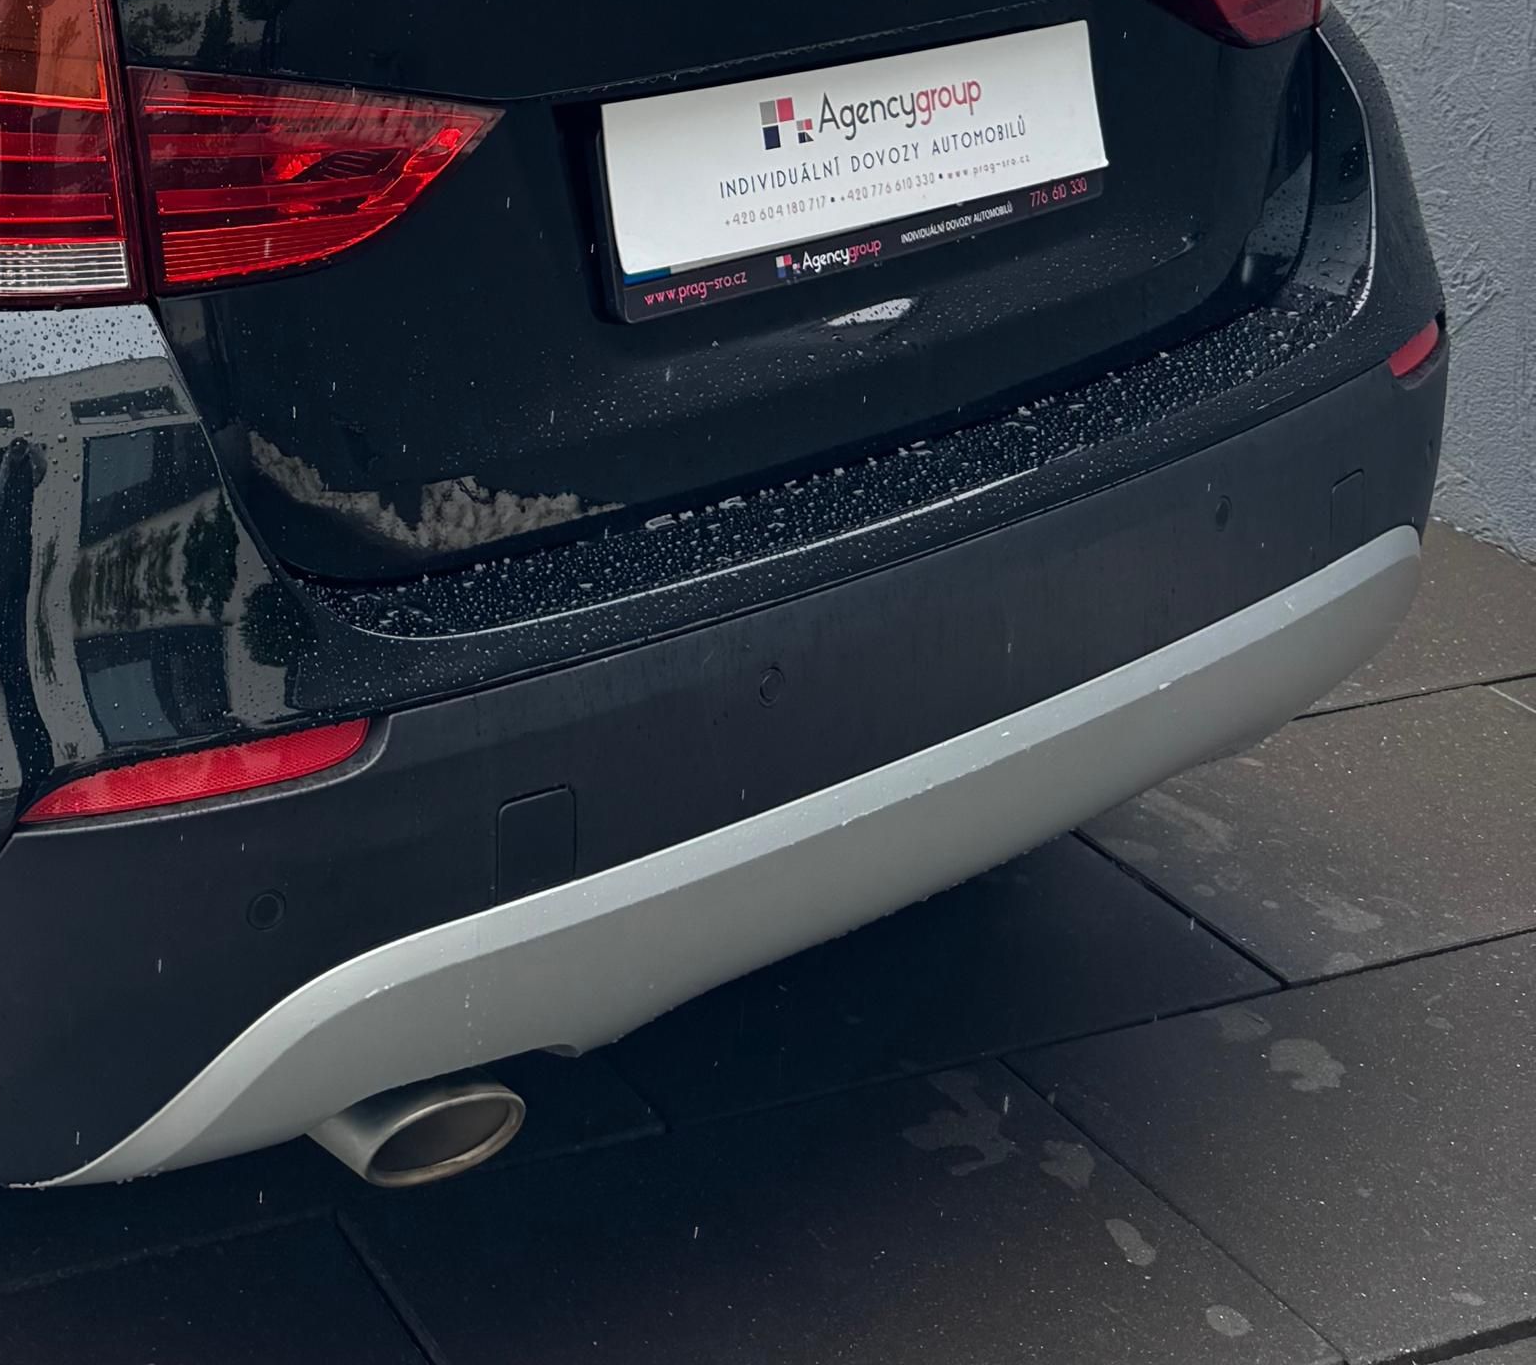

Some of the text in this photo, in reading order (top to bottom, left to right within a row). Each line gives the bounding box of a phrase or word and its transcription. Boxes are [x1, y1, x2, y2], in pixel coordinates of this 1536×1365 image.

[818, 80, 983, 141] Agencygroup
[719, 114, 1026, 199] INDIVIDUÁLNÍ DOVOZY AUTOMOBILŮ
[915, 172, 935, 188] 330
[1029, 176, 1088, 208] 776 610 330
[945, 214, 973, 232] DOVOZY
[802, 238, 882, 272] Agencygroup
[643, 270, 748, 306] www.prag-sro.cz
